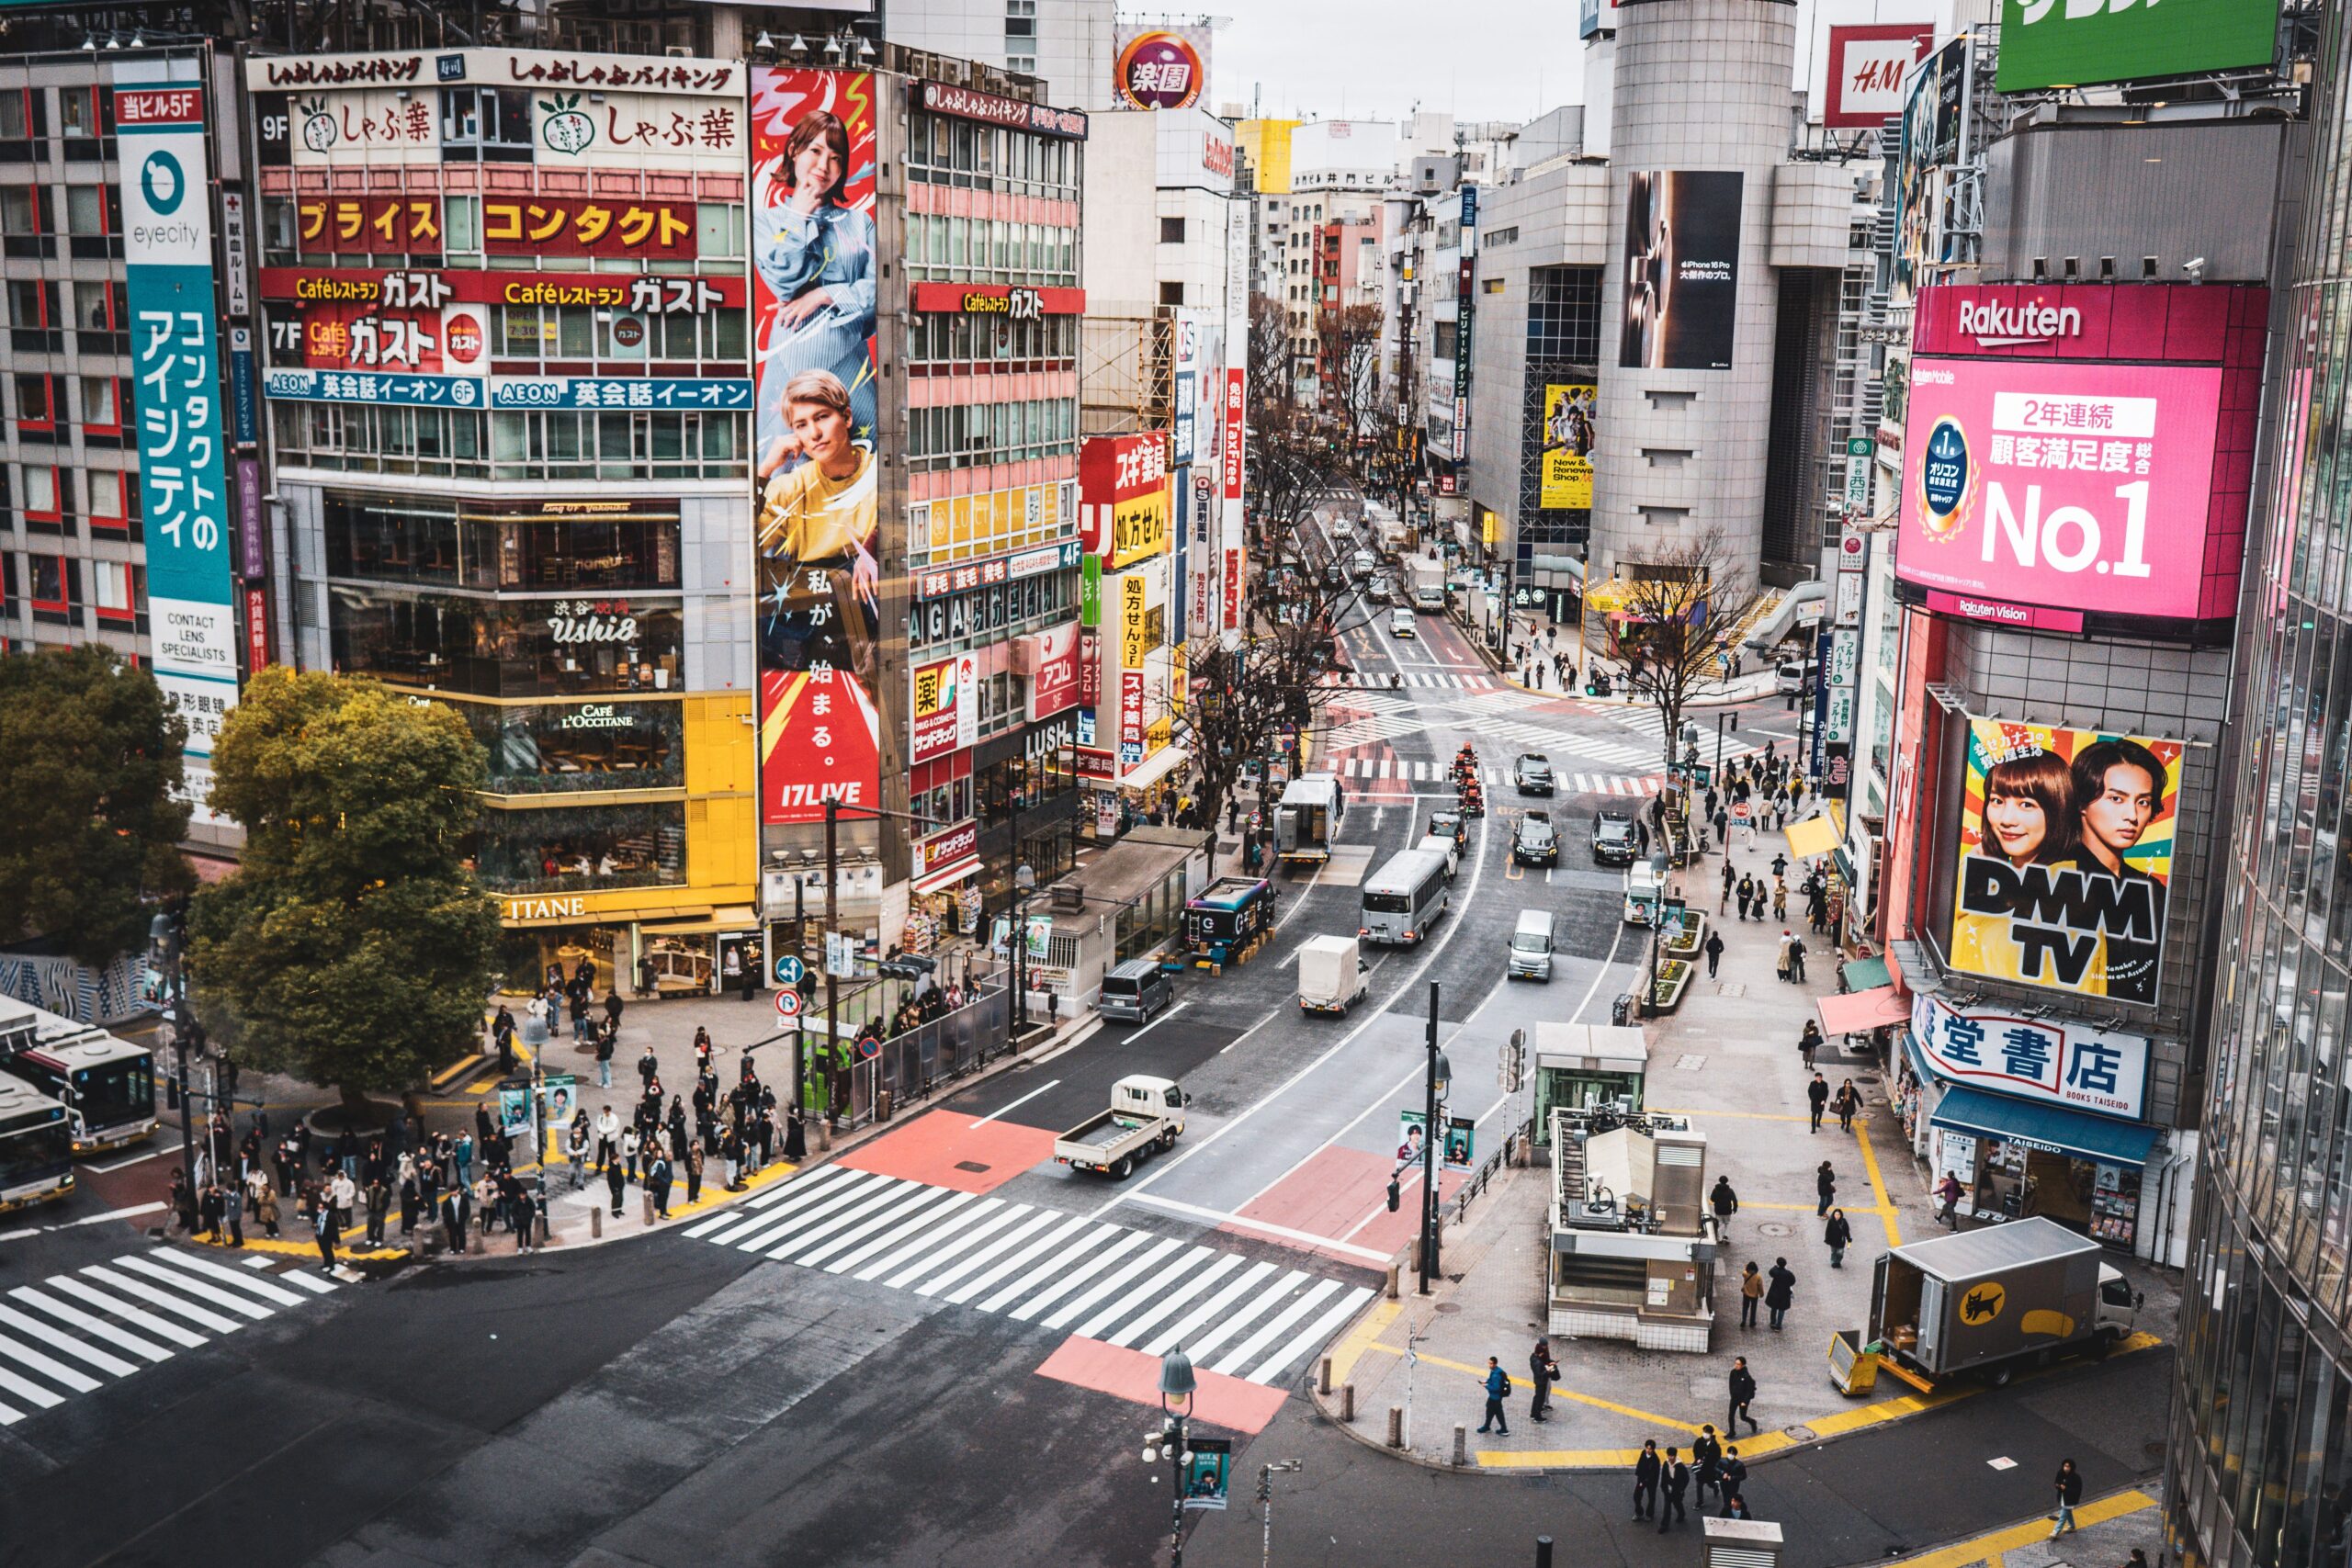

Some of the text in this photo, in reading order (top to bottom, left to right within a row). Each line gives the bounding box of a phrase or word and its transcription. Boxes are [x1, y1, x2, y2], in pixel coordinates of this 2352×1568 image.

[268, 57, 421, 85] しゃぶしゃぶバイキング
[439, 57, 461, 76] 寿司
[510, 57, 731, 90] しゃぶしゃぶバイキング
[1131, 62, 1191, 92] 楽園
[1853, 60, 1905, 93] H&M
[123, 94, 193, 119] 当ビル5F
[937, 85, 1028, 123] しゃぶしゃぶバイキング
[263, 117, 288, 141] 9F
[344, 102, 430, 141] しゃぶ葉
[608, 107, 735, 149] しゃぶ葉
[1328, 173, 1393, 184] 井門ビル
[300, 202, 440, 242] プライス
[486, 203, 690, 248] コンタクト
[133, 222, 199, 250] eyecity
[229, 222, 245, 301] 献血ルーム
[383, 274, 452, 309] ガスト
[630, 278, 723, 313] ガスト
[1011, 289, 1044, 319] ガスト
[1959, 299, 2080, 336] Rakuten
[272, 322, 301, 349] 7F
[310, 321, 346, 343] Café
[350, 316, 435, 365] ガスト
[451, 336, 480, 350] ガスト
[618, 330, 640, 338] ガスト
[311, 344, 346, 357] レストラン
[271, 376, 311, 394] AEON
[323, 375, 445, 402] 英会話イーオン
[453, 386, 472, 401] 6F
[500, 385, 559, 404] AEON
[576, 382, 747, 406] 英会話イーオン
[2024, 400, 2113, 430] 2年連続
[139, 310, 187, 548] アイシティ
[180, 312, 218, 551] コンタクトの
[1227, 421, 1240, 486] TaxFree
[1990, 435, 2153, 474] 顧客満足度 総合
[1116, 445, 1165, 490] スギ薬局
[1554, 474, 1578, 482] Shop
[1929, 462, 1960, 478] オリコン
[1196, 478, 1209, 501] OS
[1849, 476, 1865, 501] 西村
[1029, 504, 1039, 522] 5F
[1116, 504, 1163, 556] 処方せん
[1982, 480, 2151, 578] No.1
[1064, 543, 1080, 565] 4F
[168, 614, 214, 629] CONTACT
[555, 602, 588, 615] 渋谷
[910, 599, 964, 640] AGA
[1126, 579, 1141, 642] 処方せん
[1960, 600, 2027, 621] Rakuten Vision
[179, 629, 206, 643] LENS
[548, 618, 638, 643] Ushi8
[162, 643, 226, 660] SPECIALISTS
[1129, 644, 1137, 665] 3F
[808, 570, 834, 766] 私が、始まる。
[1044, 660, 1071, 690] アコム
[1083, 664, 1092, 692] アコム
[919, 673, 935, 713] 薬
[1123, 676, 1140, 740] スギ薬局
[915, 724, 957, 752] サンドラッグ
[1026, 720, 1067, 761] LUSH
[1122, 743, 1131, 753] 24
[1973, 732, 2044, 756] 幸せカナコの
[1123, 754, 1139, 762] 営業
[1828, 755, 1848, 785] HUB
[1980, 743, 2044, 770] 殺し屋生活
[782, 782, 861, 807] 17LIVE
[941, 829, 975, 855] サンドラッグ
[1962, 856, 2154, 942] DMM
[2012, 923, 2098, 986] TV
[2105, 959, 2137, 972] Kanako's
[2128, 959, 2154, 977] Assassin
[2066, 1090, 2129, 1111] BOOKS TAISEIDO
[2007, 1135, 2061, 1154] TAISEIDO
